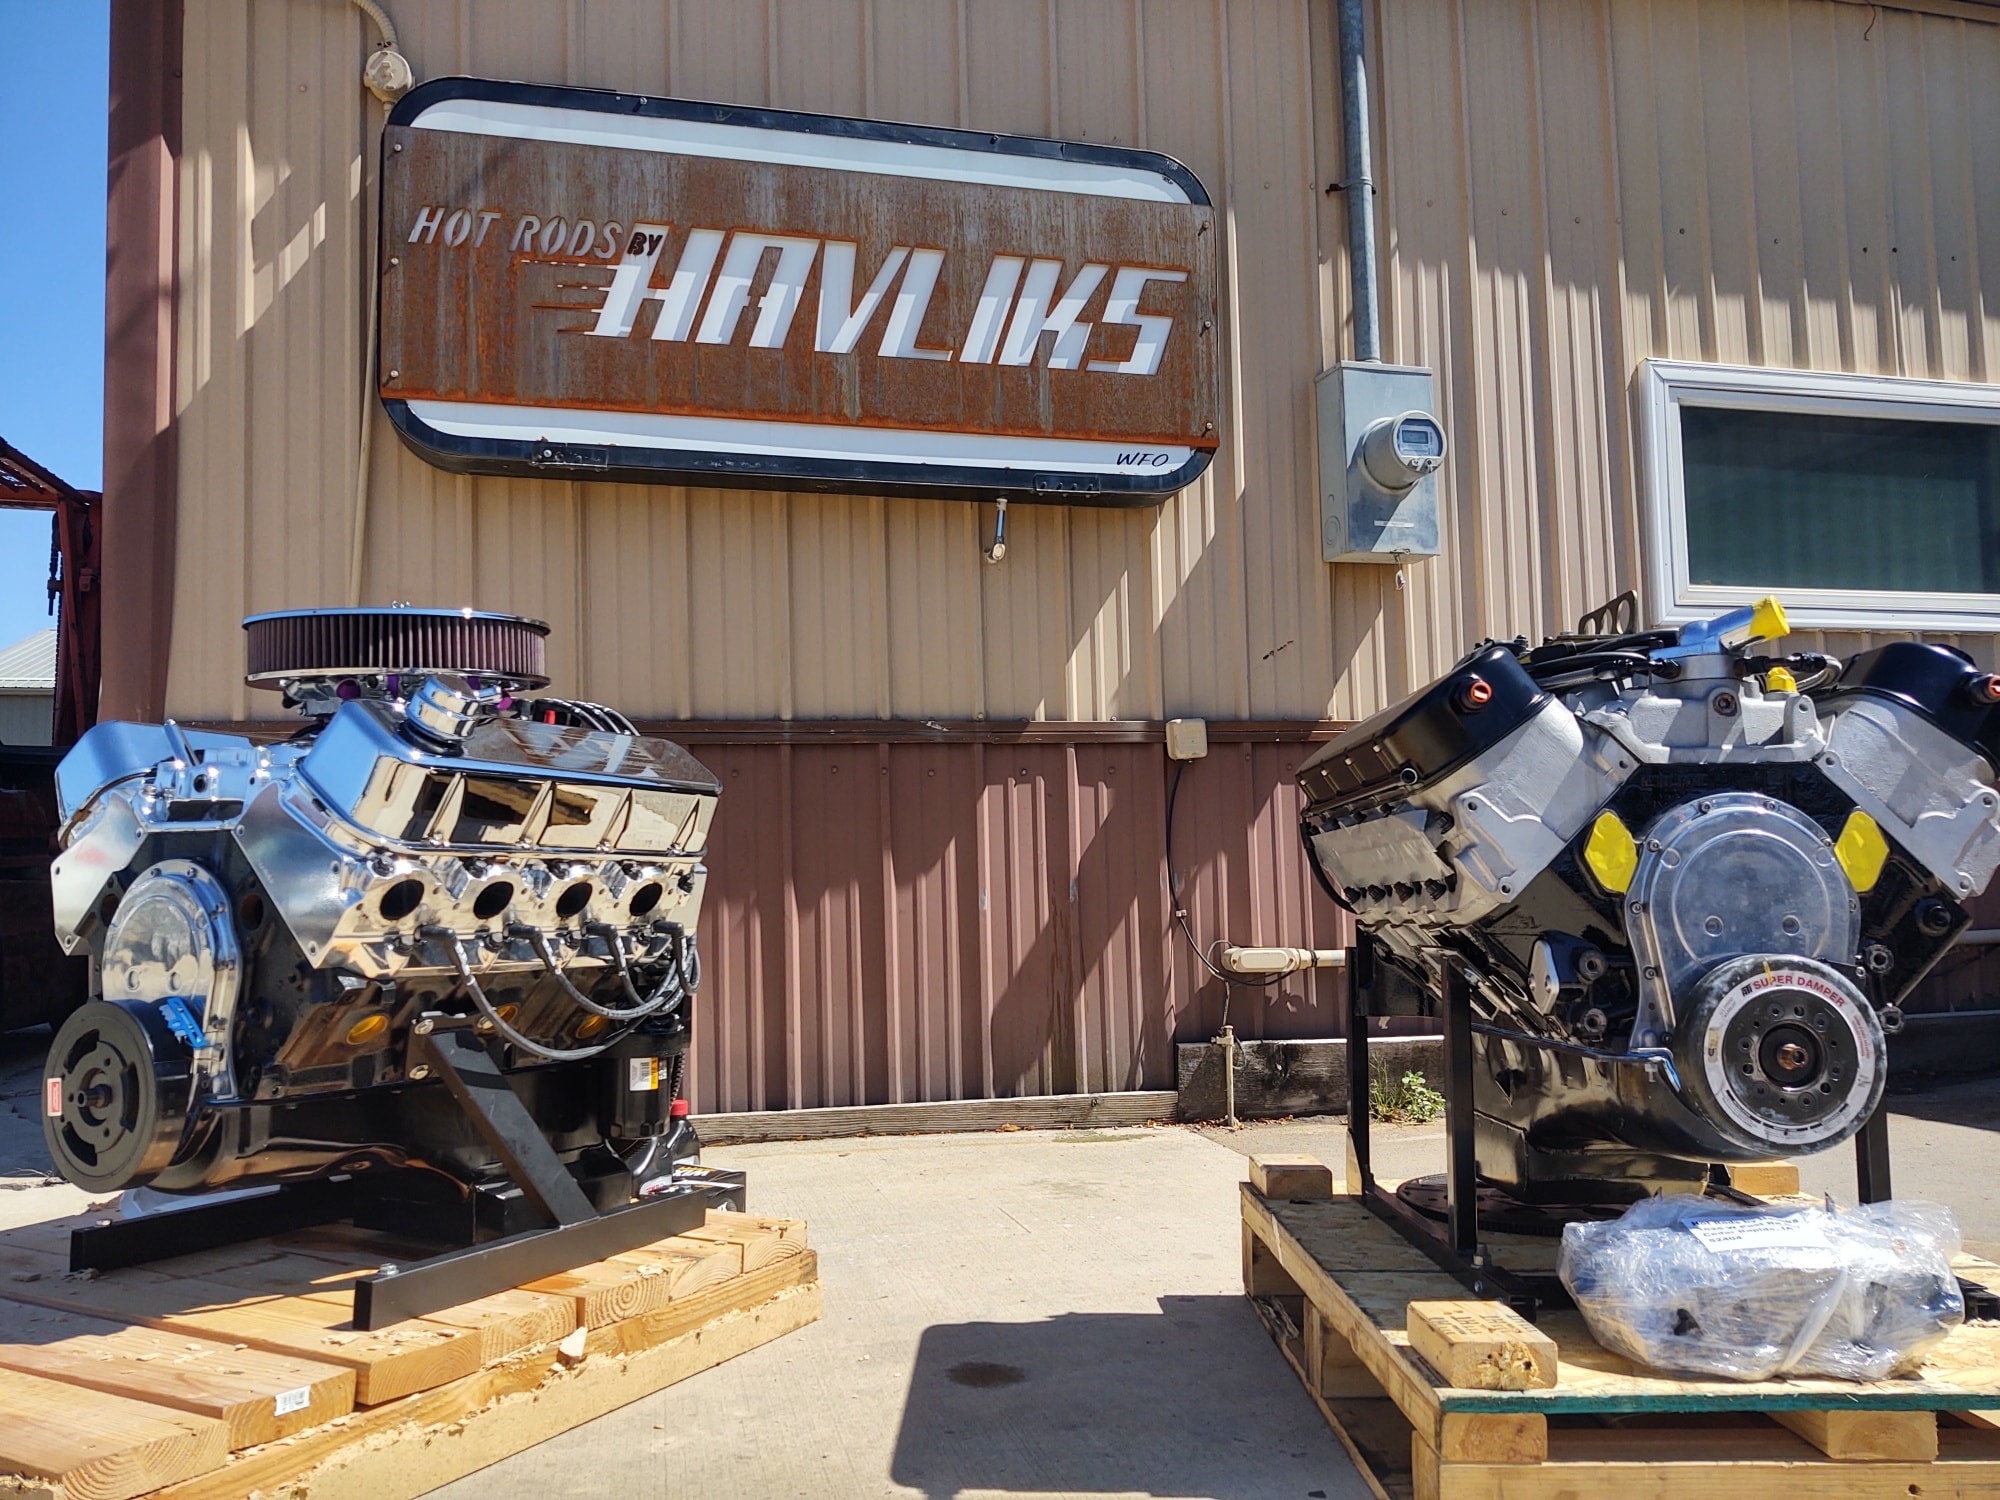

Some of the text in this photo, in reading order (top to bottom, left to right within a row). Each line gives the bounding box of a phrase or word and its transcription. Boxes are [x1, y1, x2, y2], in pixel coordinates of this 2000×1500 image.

[407, 206, 662, 260] HOT RODS BY
[585, 223, 1189, 376] HAVLIKS
[1116, 452, 1169, 467] WFO
[1753, 975, 1793, 990] SUPER
[1797, 976, 1846, 1007] DAMPER
